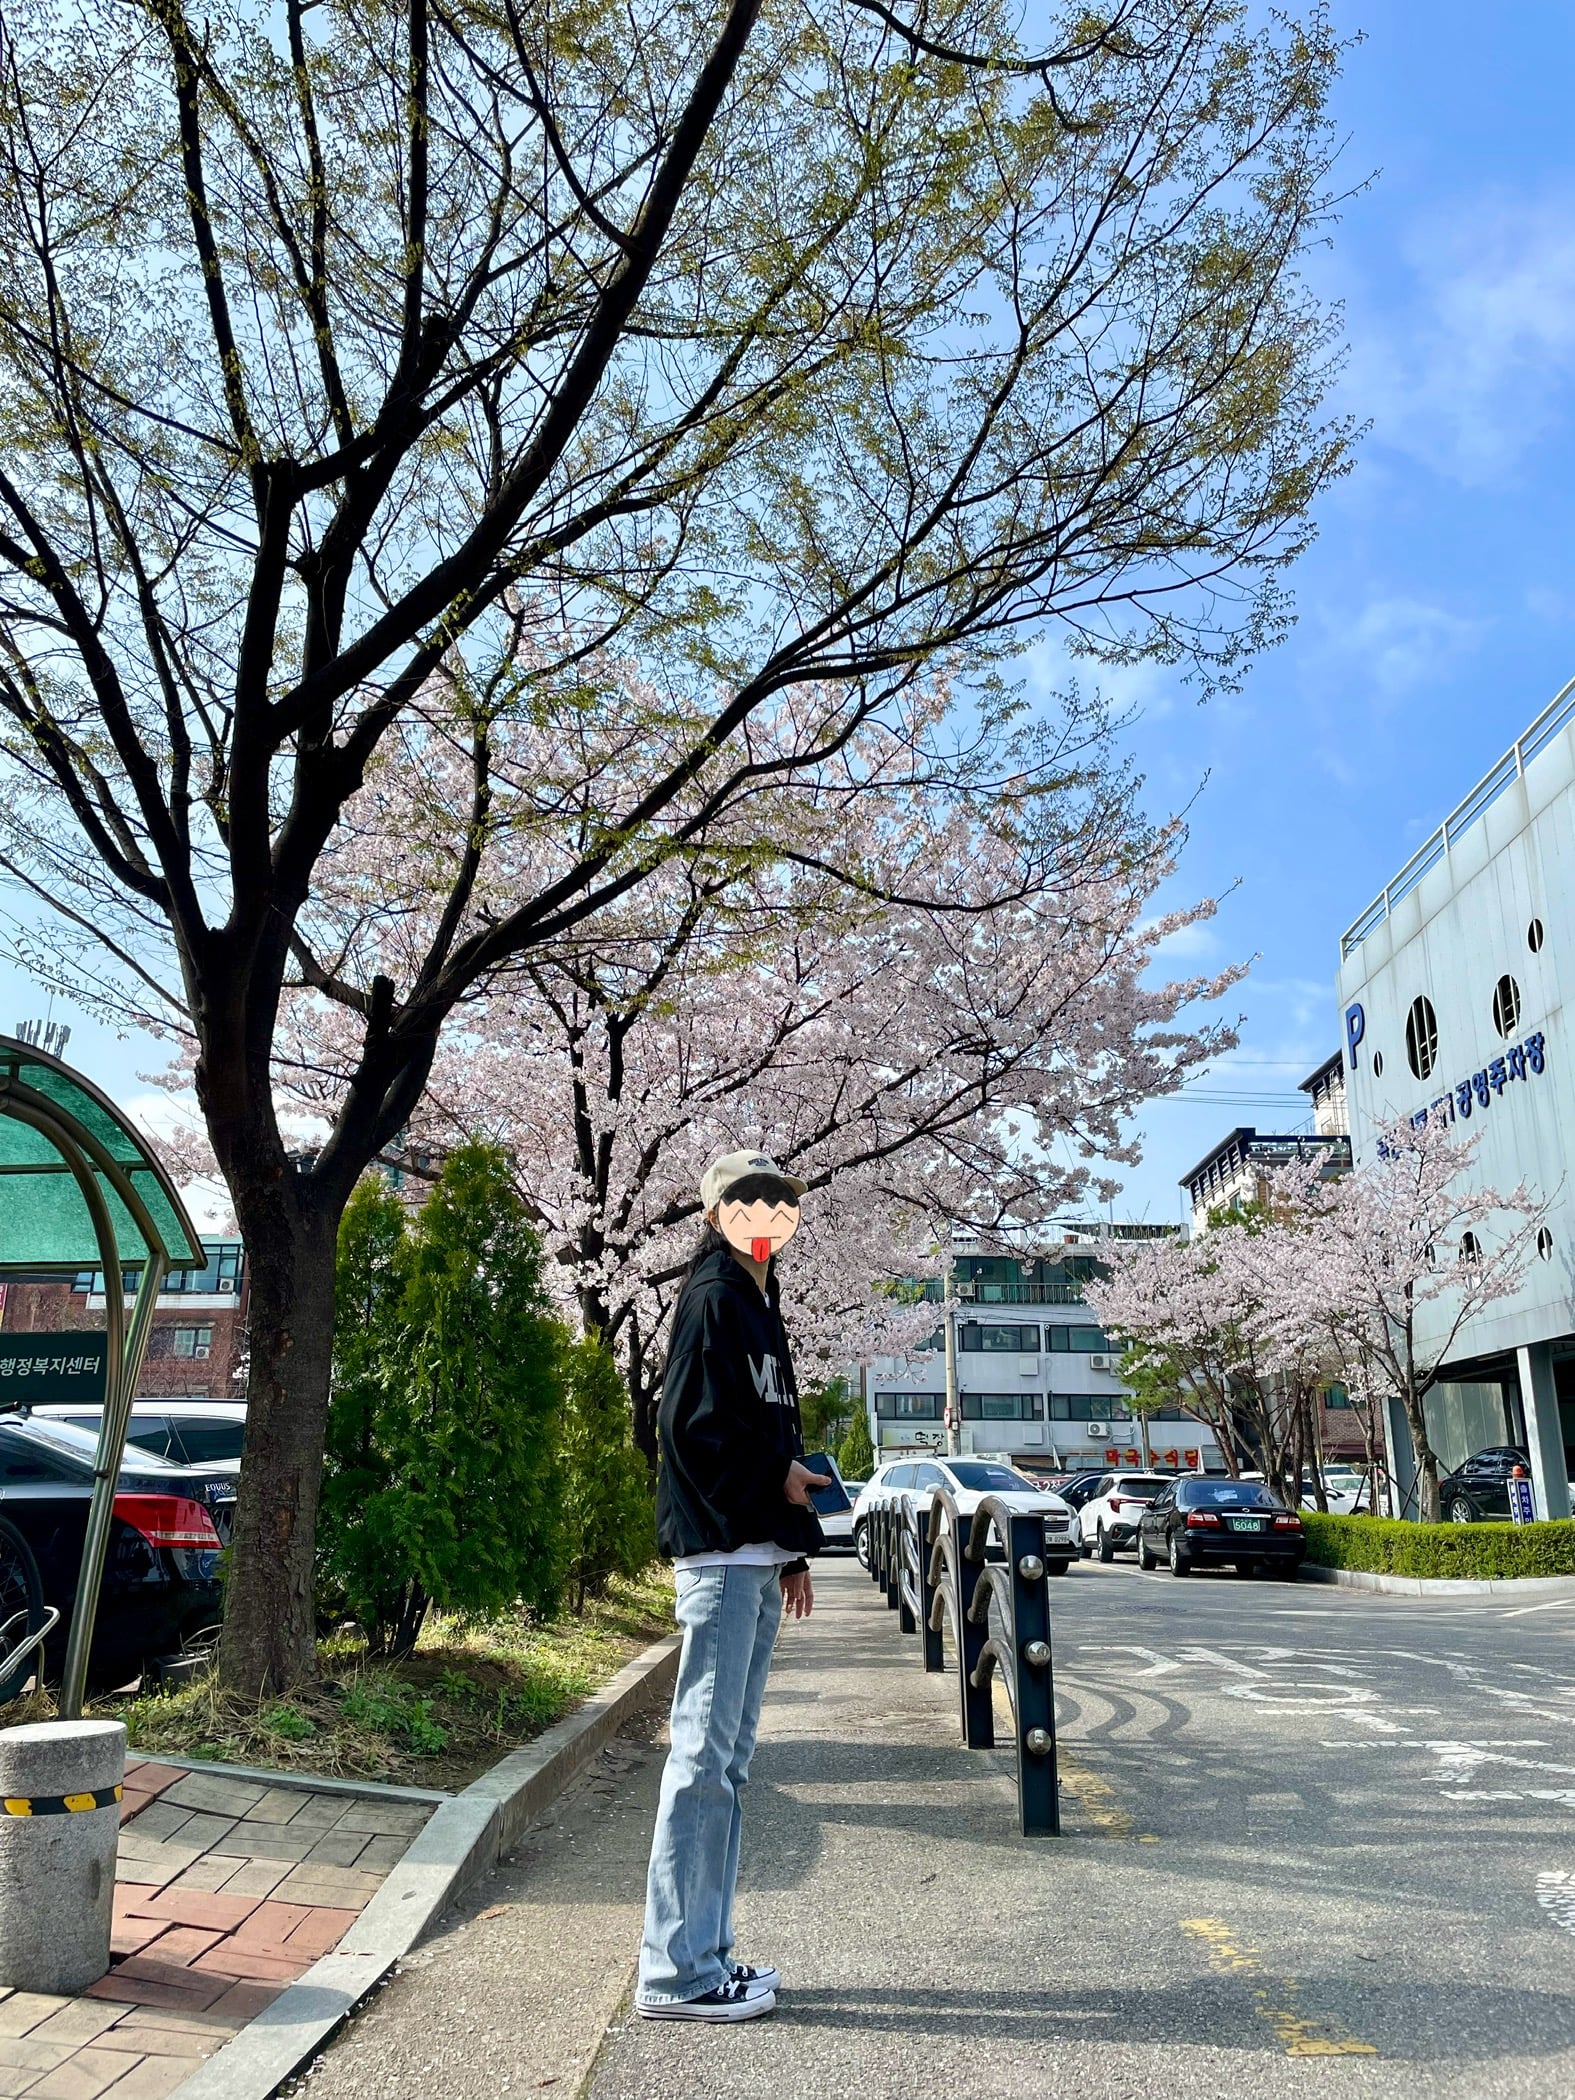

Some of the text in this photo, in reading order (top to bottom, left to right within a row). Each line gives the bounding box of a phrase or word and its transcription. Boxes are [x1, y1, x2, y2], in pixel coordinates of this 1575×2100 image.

[1345, 1003, 1365, 1069] P
[1455, 1032, 1545, 1118] 공영주차장
[0, 1356, 100, 1376] 행정복지센터
[205, 1483, 230, 1491] EQUUS
[1235, 1521, 1259, 1530] 5048
